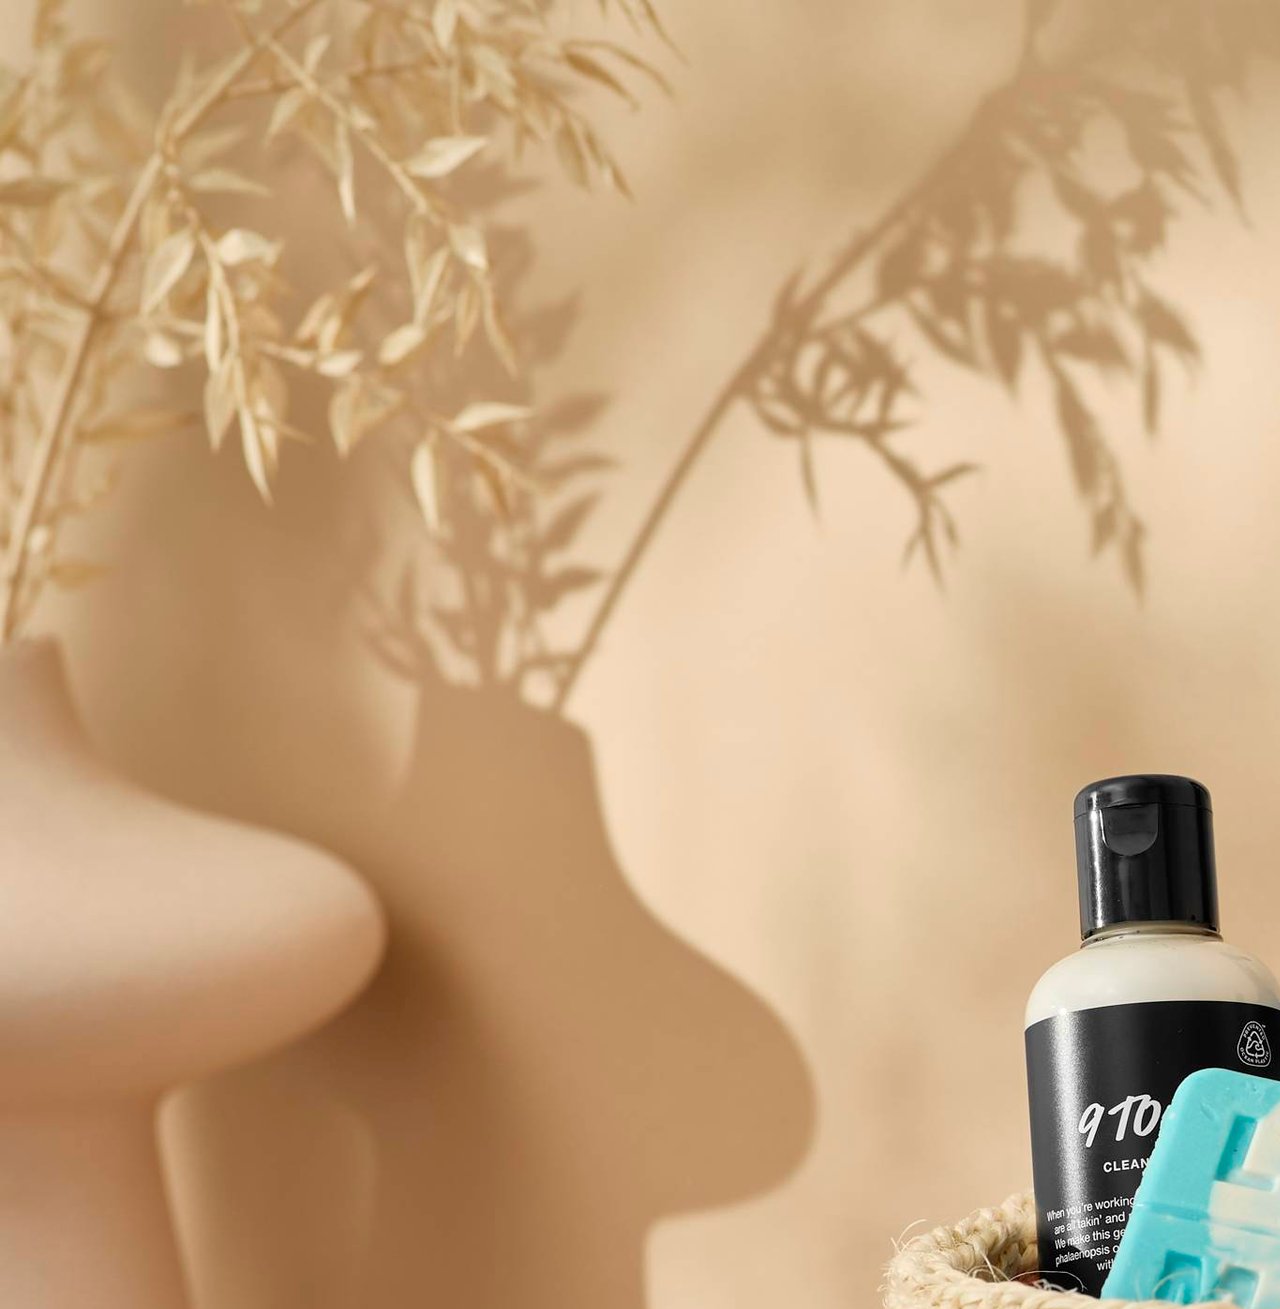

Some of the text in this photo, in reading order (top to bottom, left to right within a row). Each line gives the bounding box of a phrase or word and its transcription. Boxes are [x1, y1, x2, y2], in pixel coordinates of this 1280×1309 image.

[1078, 1094, 1162, 1148] 9 TO
[1046, 1208, 1065, 1222] When
[1105, 1211, 1126, 1225] and
[1067, 1234, 1091, 1247] make
[1092, 1229, 1111, 1242] this
[1055, 1244, 1111, 1268] phalaenopsis
